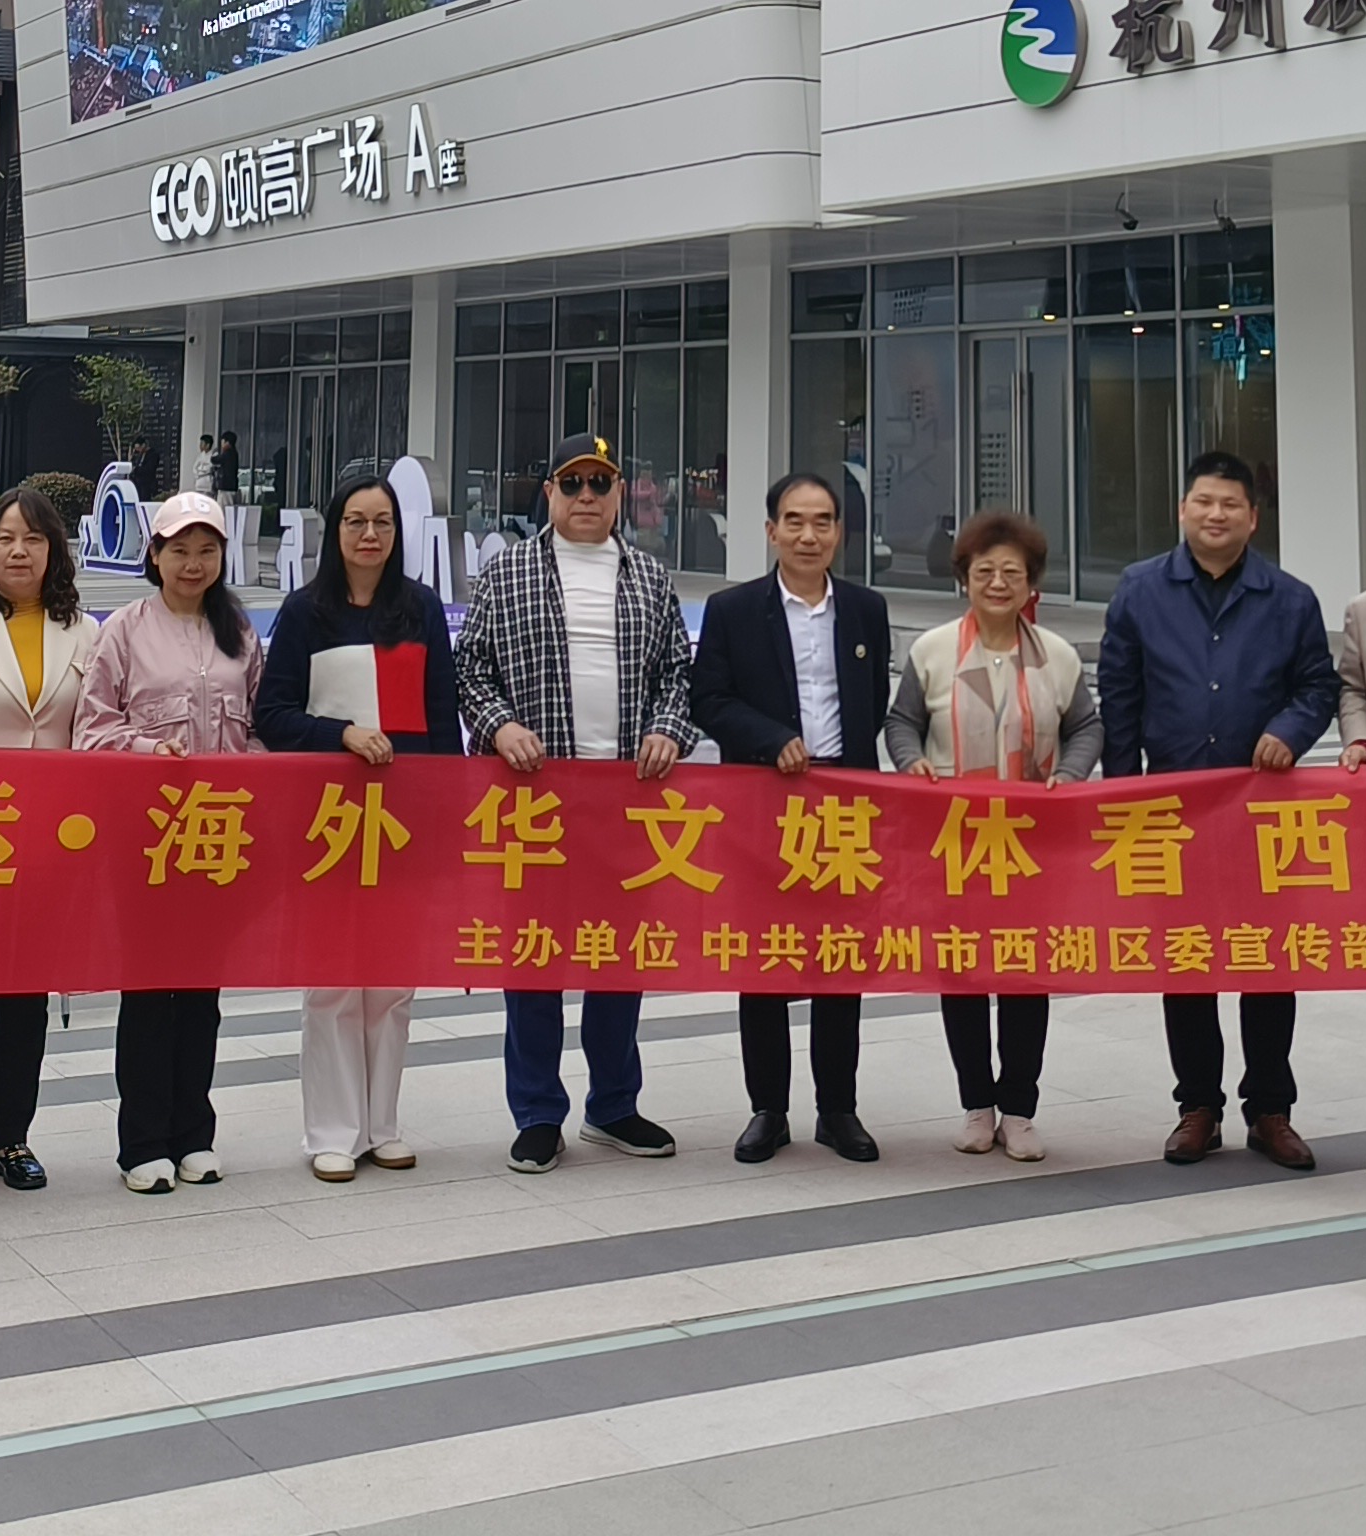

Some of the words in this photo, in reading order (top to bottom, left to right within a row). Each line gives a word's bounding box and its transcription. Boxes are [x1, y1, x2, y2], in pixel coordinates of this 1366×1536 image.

[202, 20, 213, 37] As
[219, 7, 246, 30] historic
[221, 115, 385, 229] 颐高广场
[405, 102, 466, 194] A座
[456, 920, 677, 972] 主办单位
